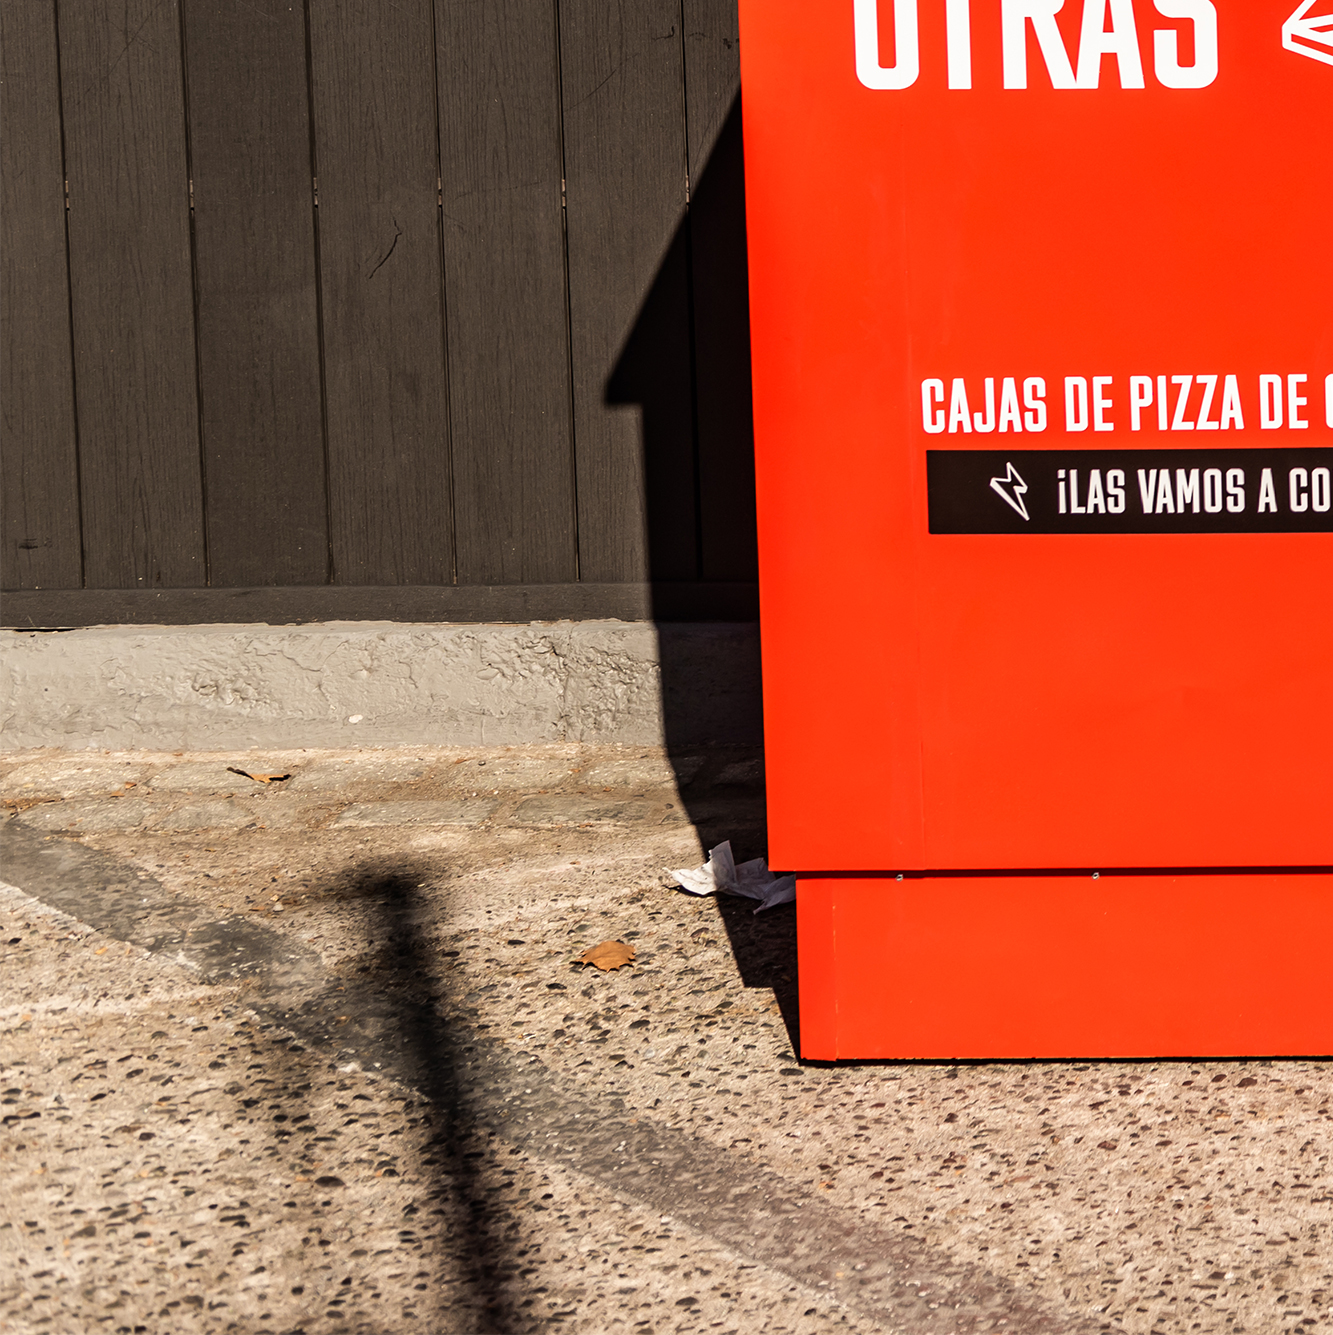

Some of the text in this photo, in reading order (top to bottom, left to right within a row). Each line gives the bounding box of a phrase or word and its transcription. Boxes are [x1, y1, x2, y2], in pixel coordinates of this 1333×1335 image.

[920, 376, 1048, 434] CAJAS
[1065, 375, 1115, 432] DE
[1130, 373, 1245, 432] PIZZA
[1260, 373, 1309, 430] DE
[1057, 469, 1126, 515] ¡LAS
[1137, 467, 1245, 514] VAMOS
[1257, 467, 1278, 513] A
